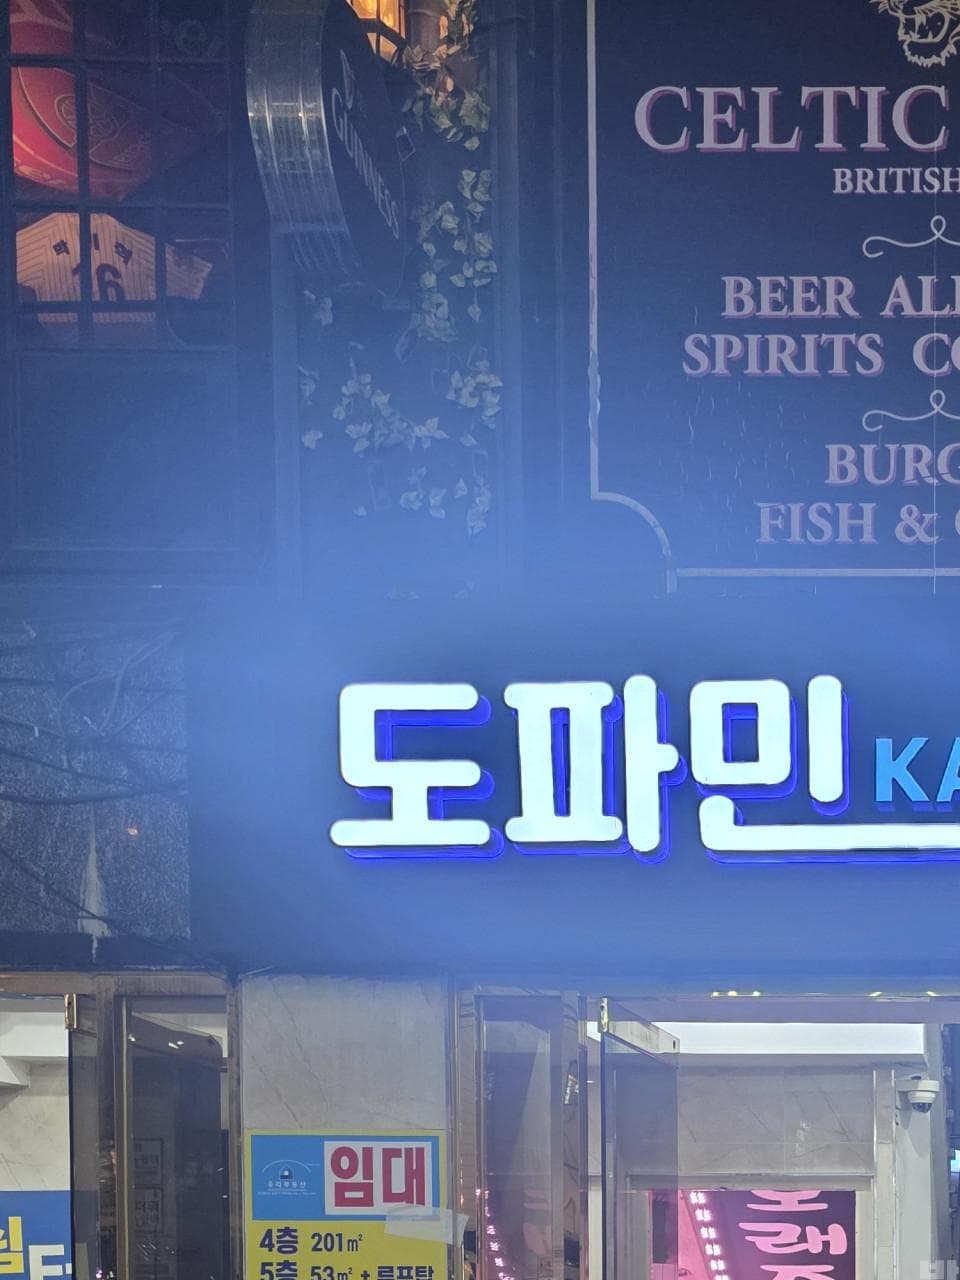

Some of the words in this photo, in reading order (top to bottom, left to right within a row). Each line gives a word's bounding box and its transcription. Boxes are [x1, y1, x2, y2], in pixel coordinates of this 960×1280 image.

[635, 84, 949, 153] CELTIC
[332, 87, 399, 240] GUINNESS
[721, 275, 858, 319] BEER
[683, 333, 884, 378] SPIRITS
[756, 502, 877, 545] FISH
[895, 503, 940, 545] &
[330, 1145, 426, 1208] 임대
[259, 1227, 299, 1255] 4층
